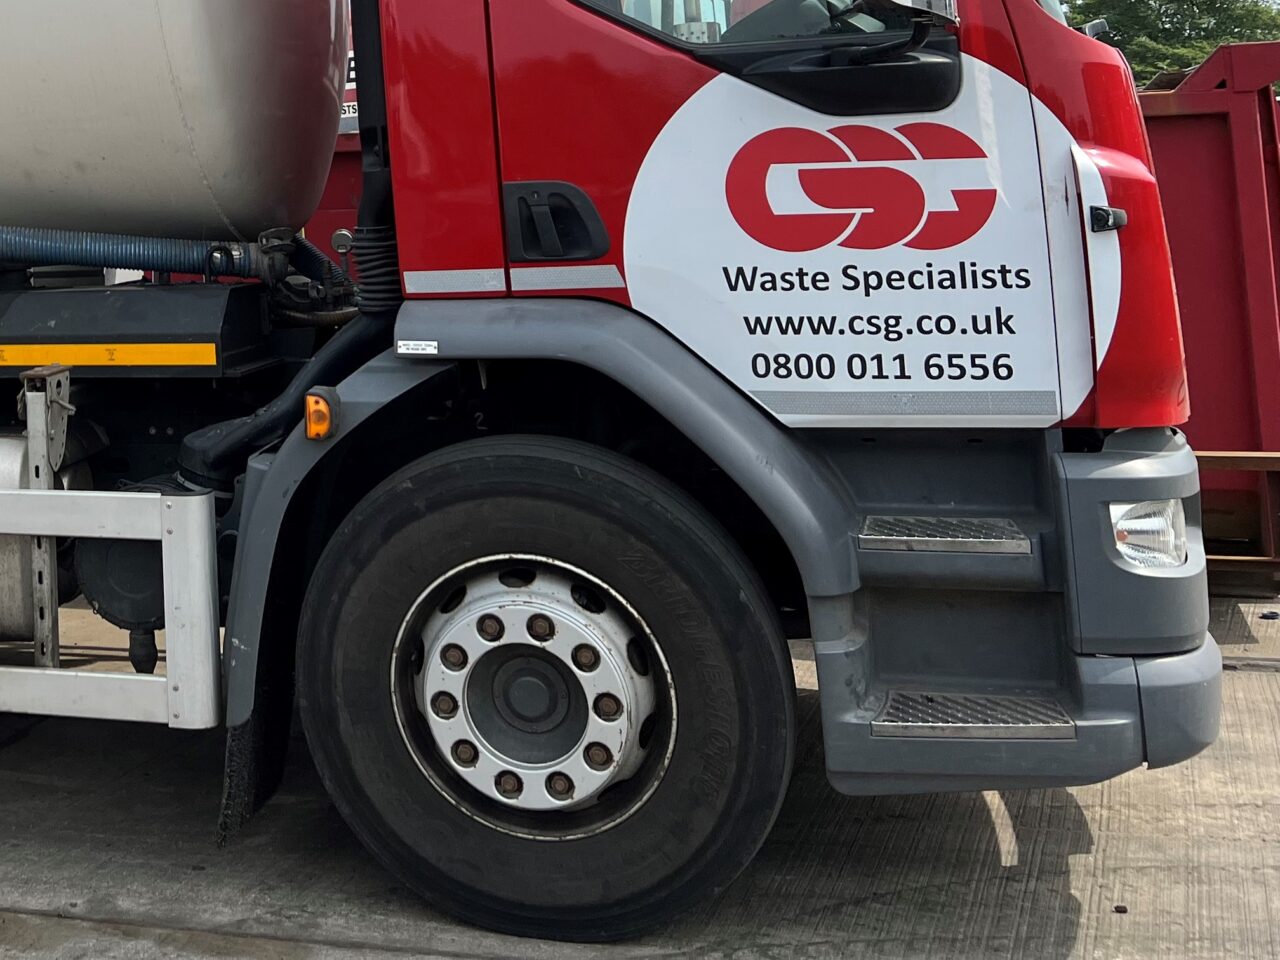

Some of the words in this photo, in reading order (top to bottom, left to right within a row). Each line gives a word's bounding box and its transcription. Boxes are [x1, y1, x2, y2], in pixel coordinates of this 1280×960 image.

[725, 122, 998, 253] CSG
[722, 264, 830, 292] Waste
[841, 261, 1032, 297] Specialists
[743, 306, 1017, 342] www.csg.co.uk
[751, 352, 836, 380] 0800
[846, 352, 912, 380] 011
[923, 352, 1014, 381] 6556
